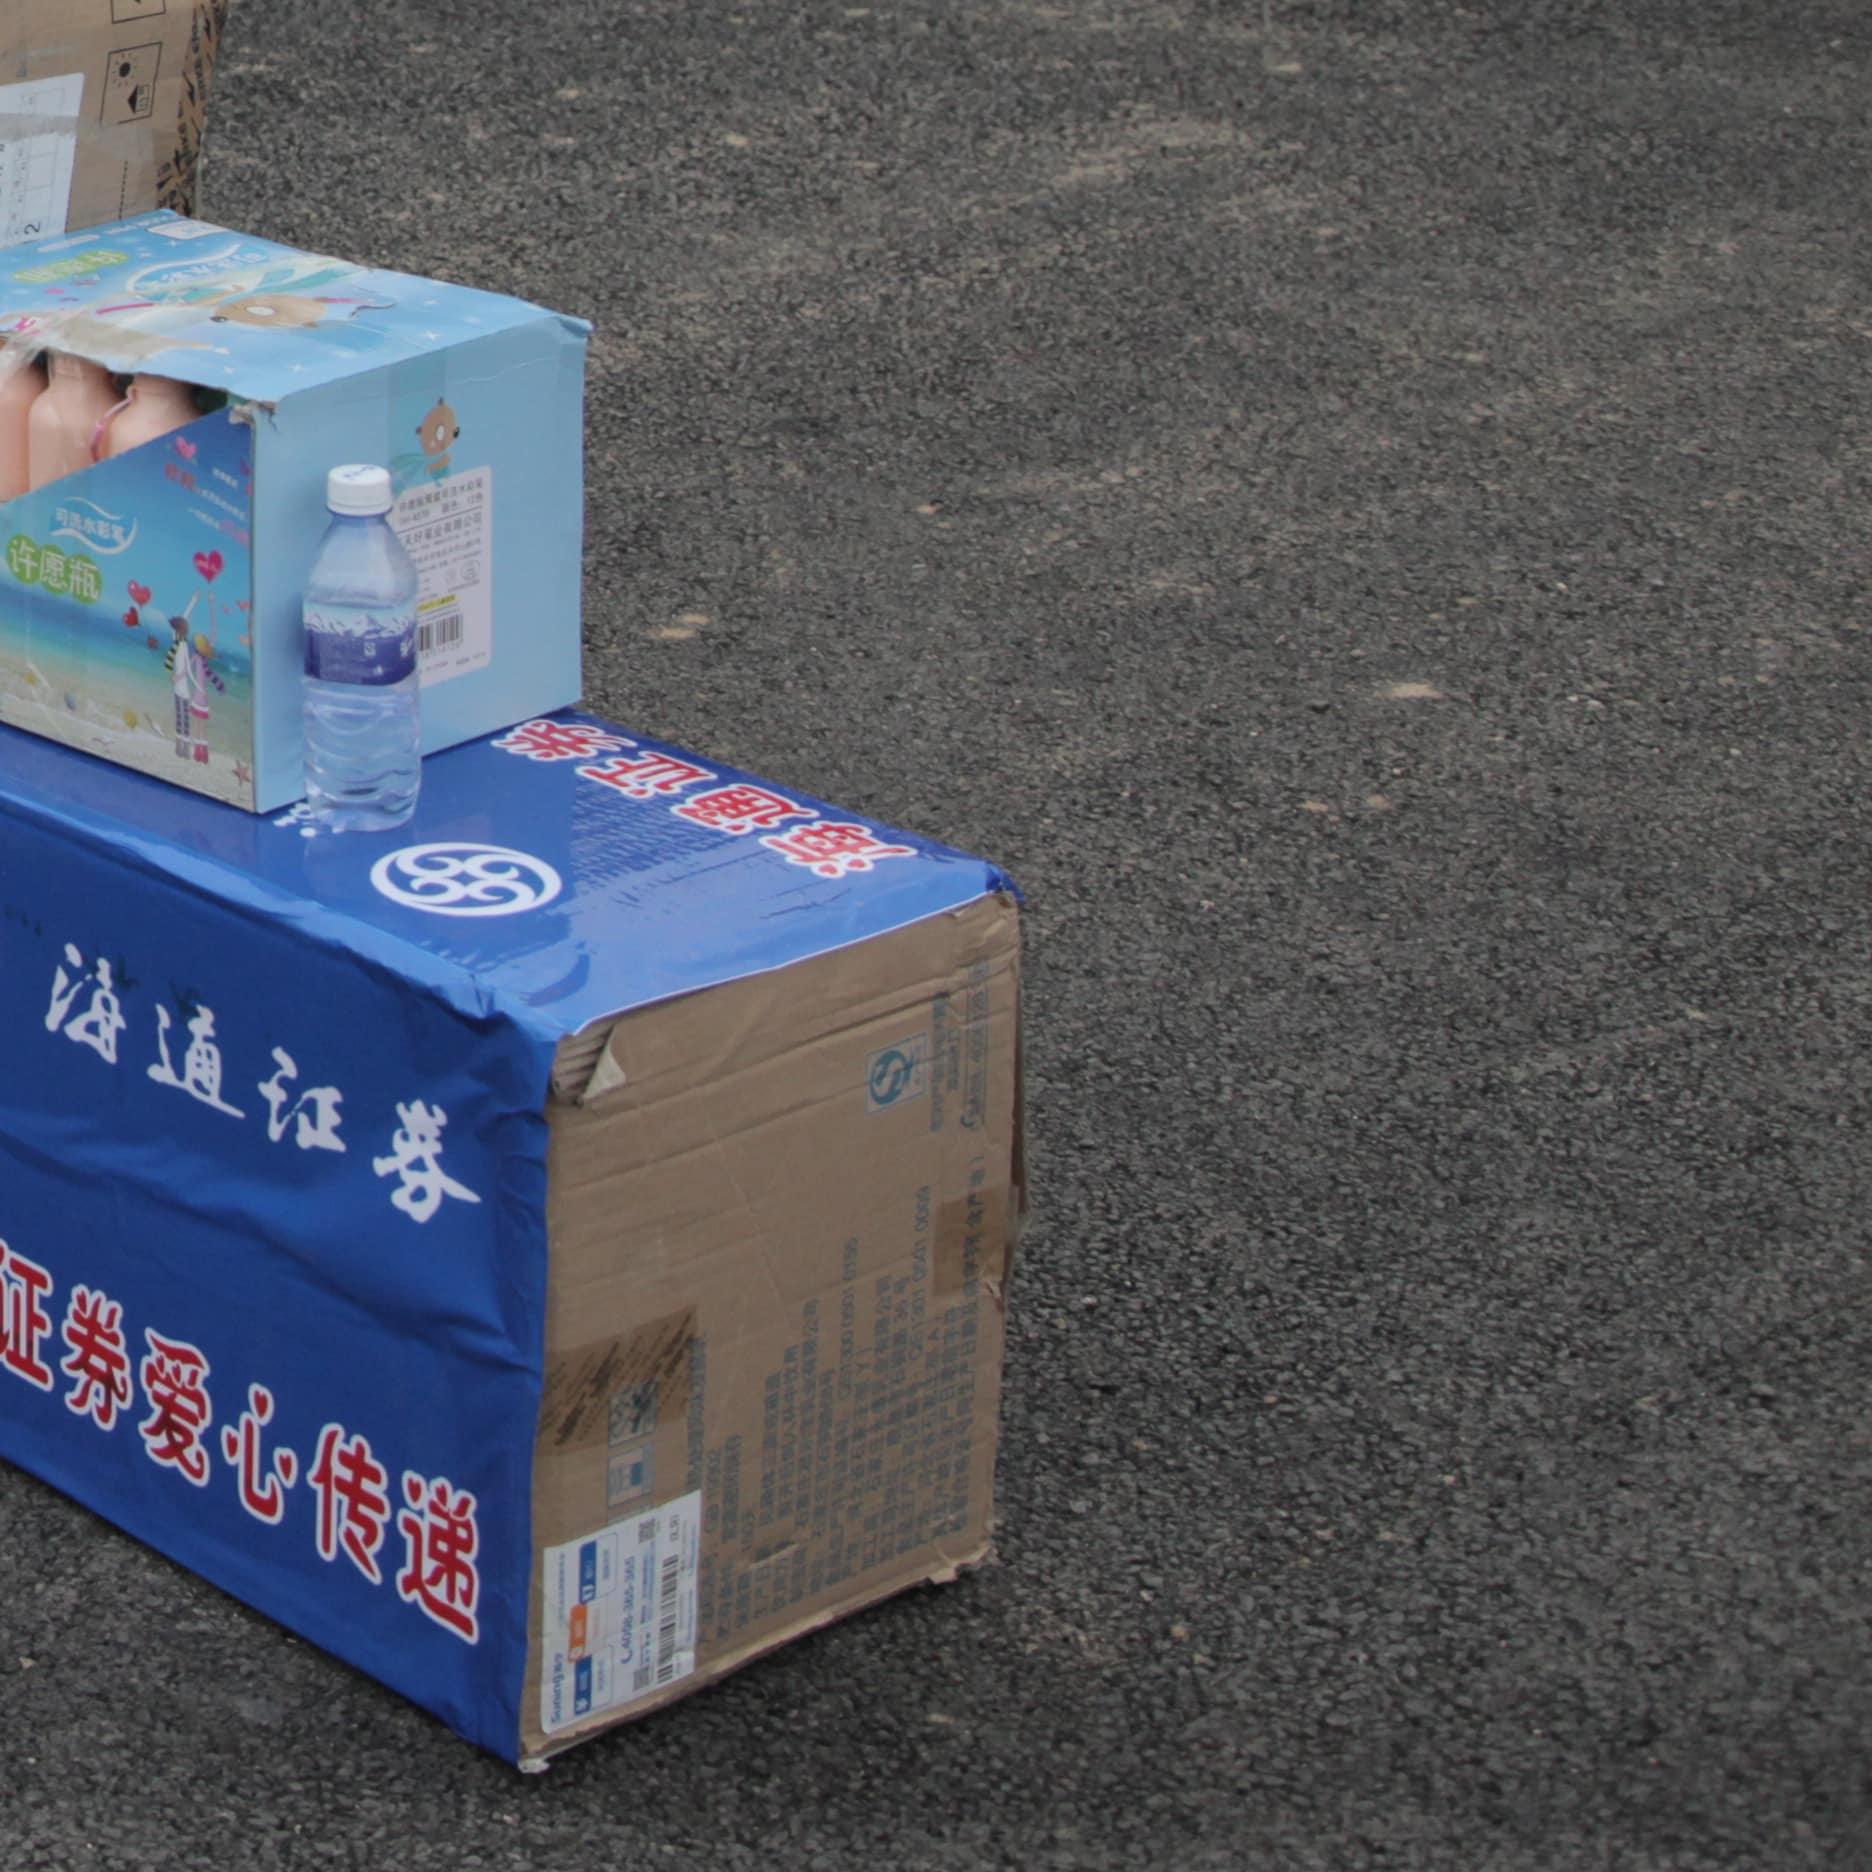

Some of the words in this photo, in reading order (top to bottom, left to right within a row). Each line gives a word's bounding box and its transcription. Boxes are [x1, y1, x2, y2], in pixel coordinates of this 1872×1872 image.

[10, 537, 101, 600] 许愿瓶
[488, 716, 920, 880] 海通证券
[42, 939, 484, 1225] 海通证券
